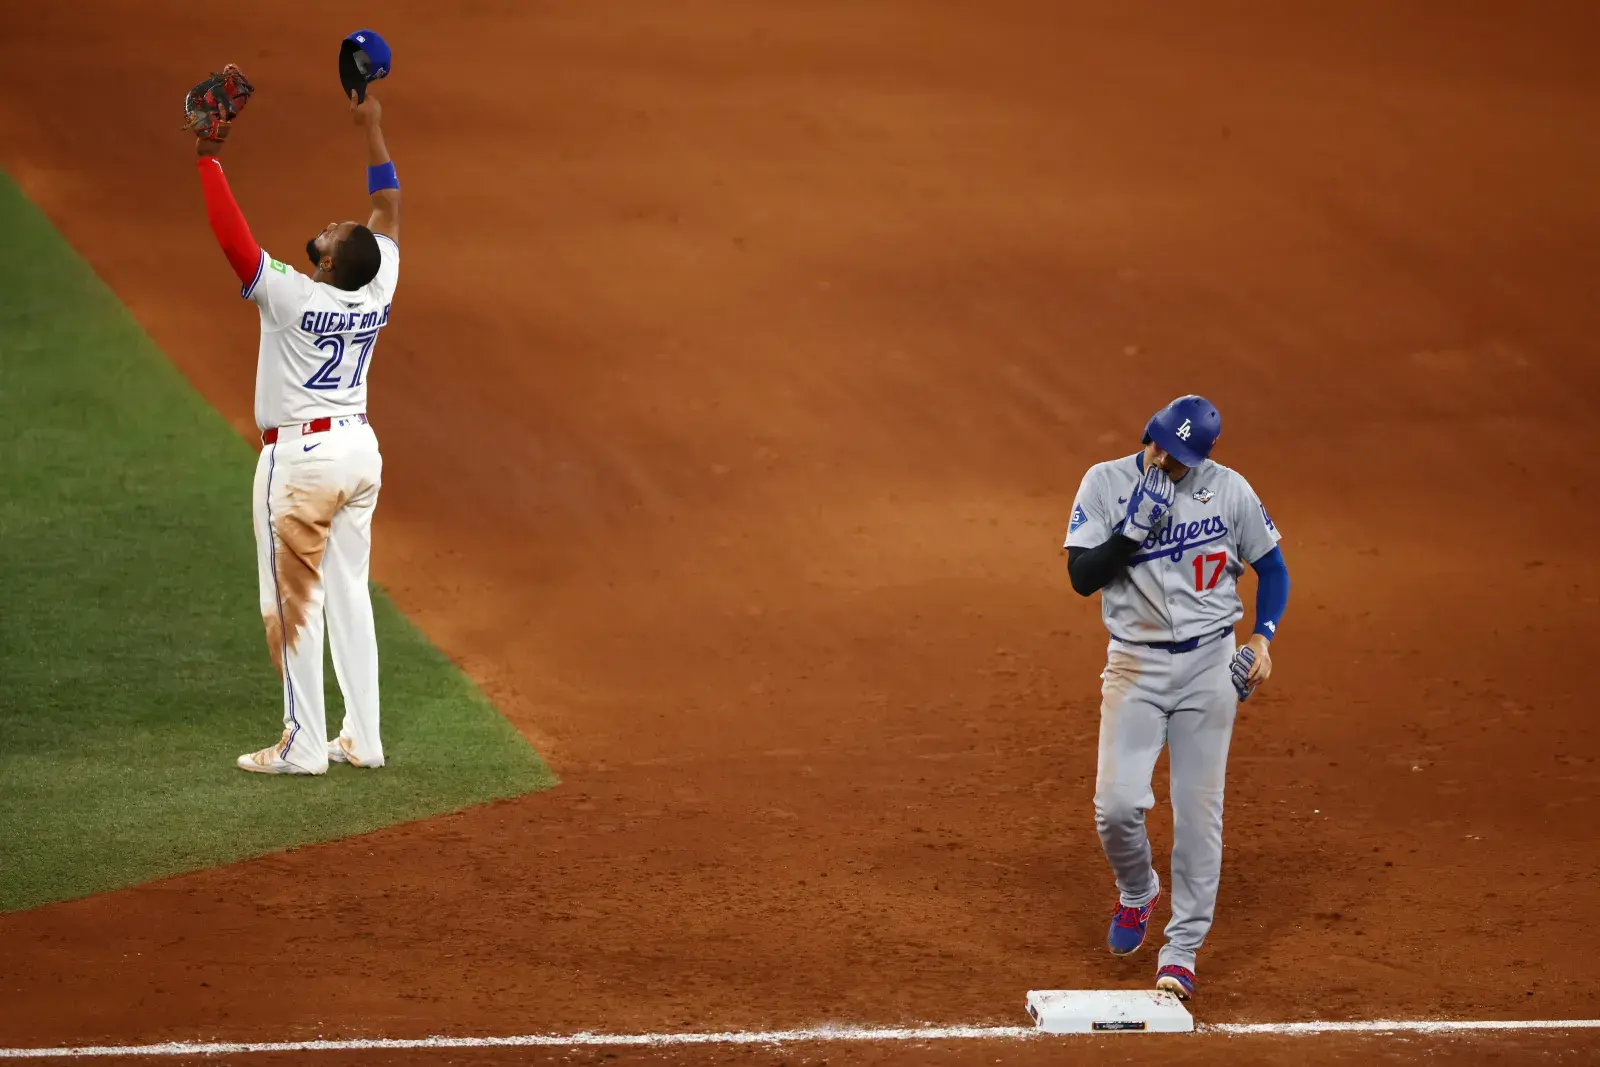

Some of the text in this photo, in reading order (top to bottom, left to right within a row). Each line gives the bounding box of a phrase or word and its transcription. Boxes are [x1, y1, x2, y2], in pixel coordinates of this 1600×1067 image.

[302, 328, 378, 390] 27
[1175, 418, 1192, 441] LA
[1128, 515, 1228, 568] odgers
[1192, 551, 1227, 592] 17
